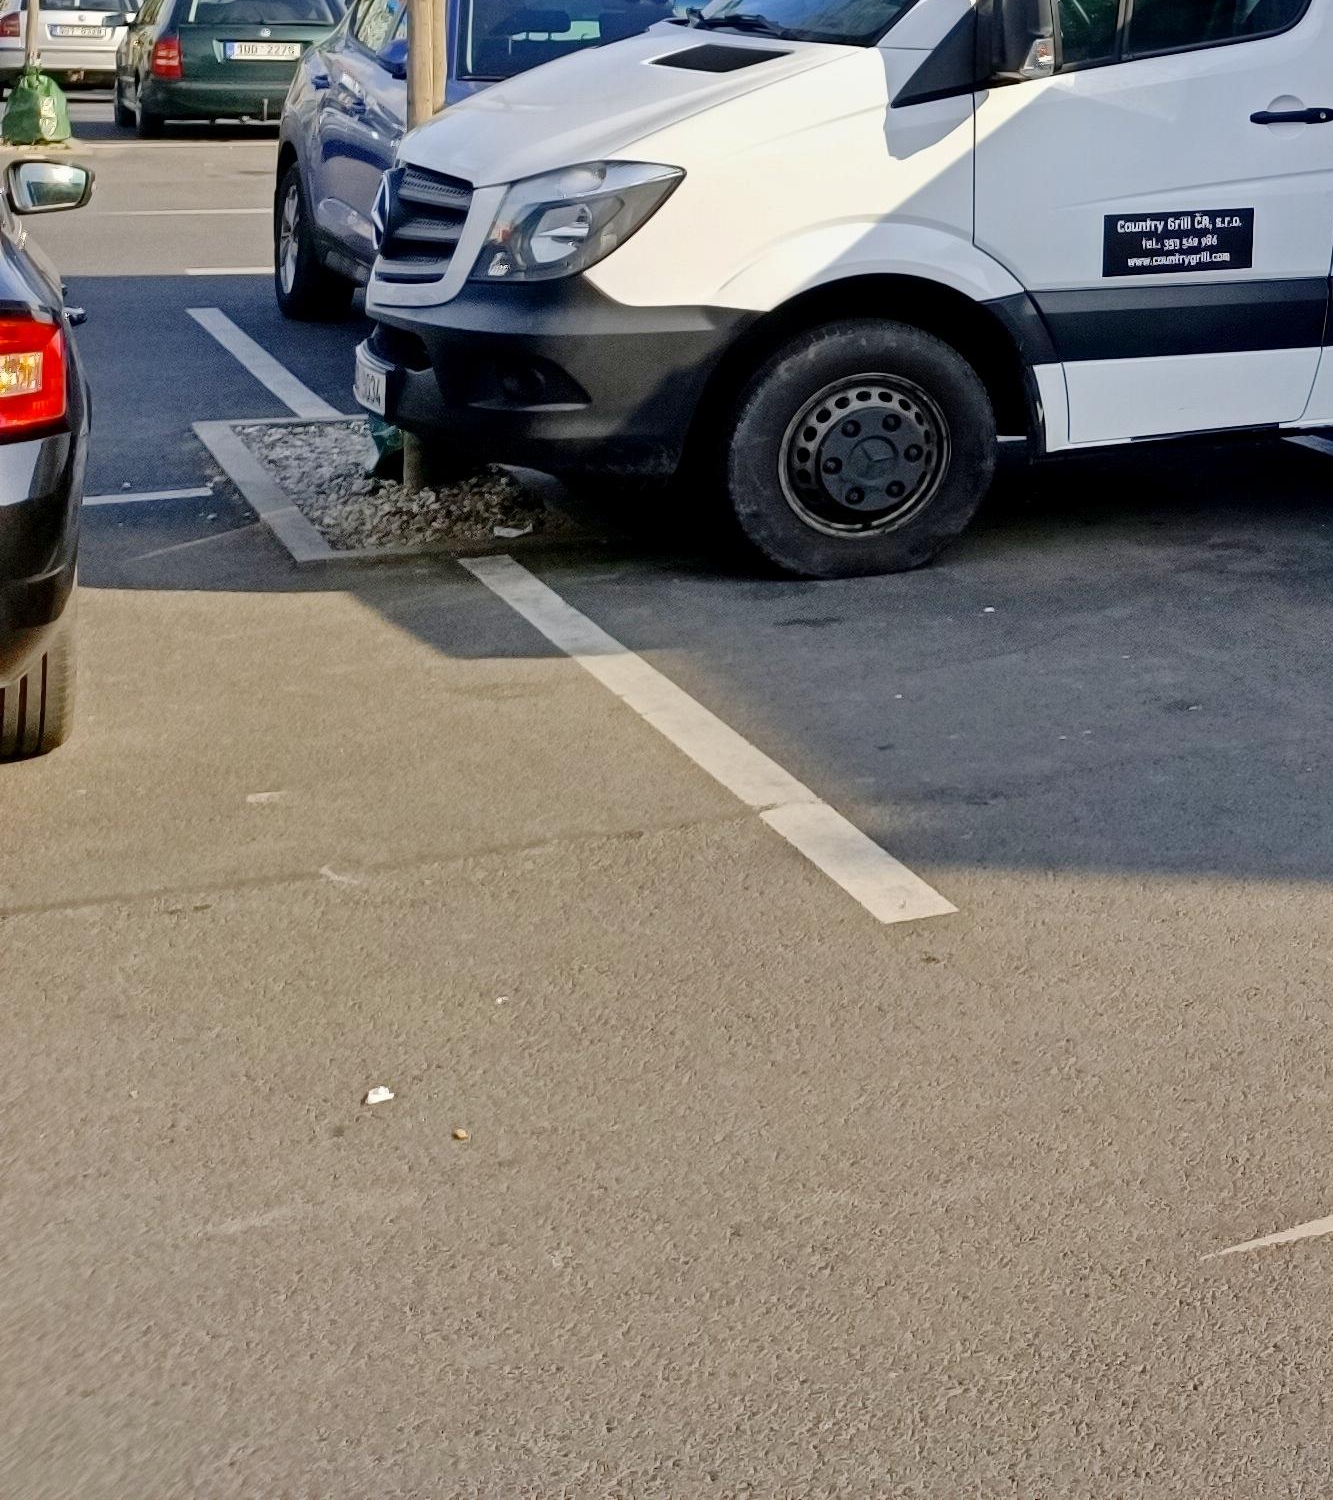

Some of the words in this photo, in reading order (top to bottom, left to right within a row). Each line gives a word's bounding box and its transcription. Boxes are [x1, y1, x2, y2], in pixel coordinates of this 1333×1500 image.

[1116, 217, 1164, 234] Country
[1167, 215, 1191, 231] Grill
[1215, 216, 1242, 228] s.r.o.
